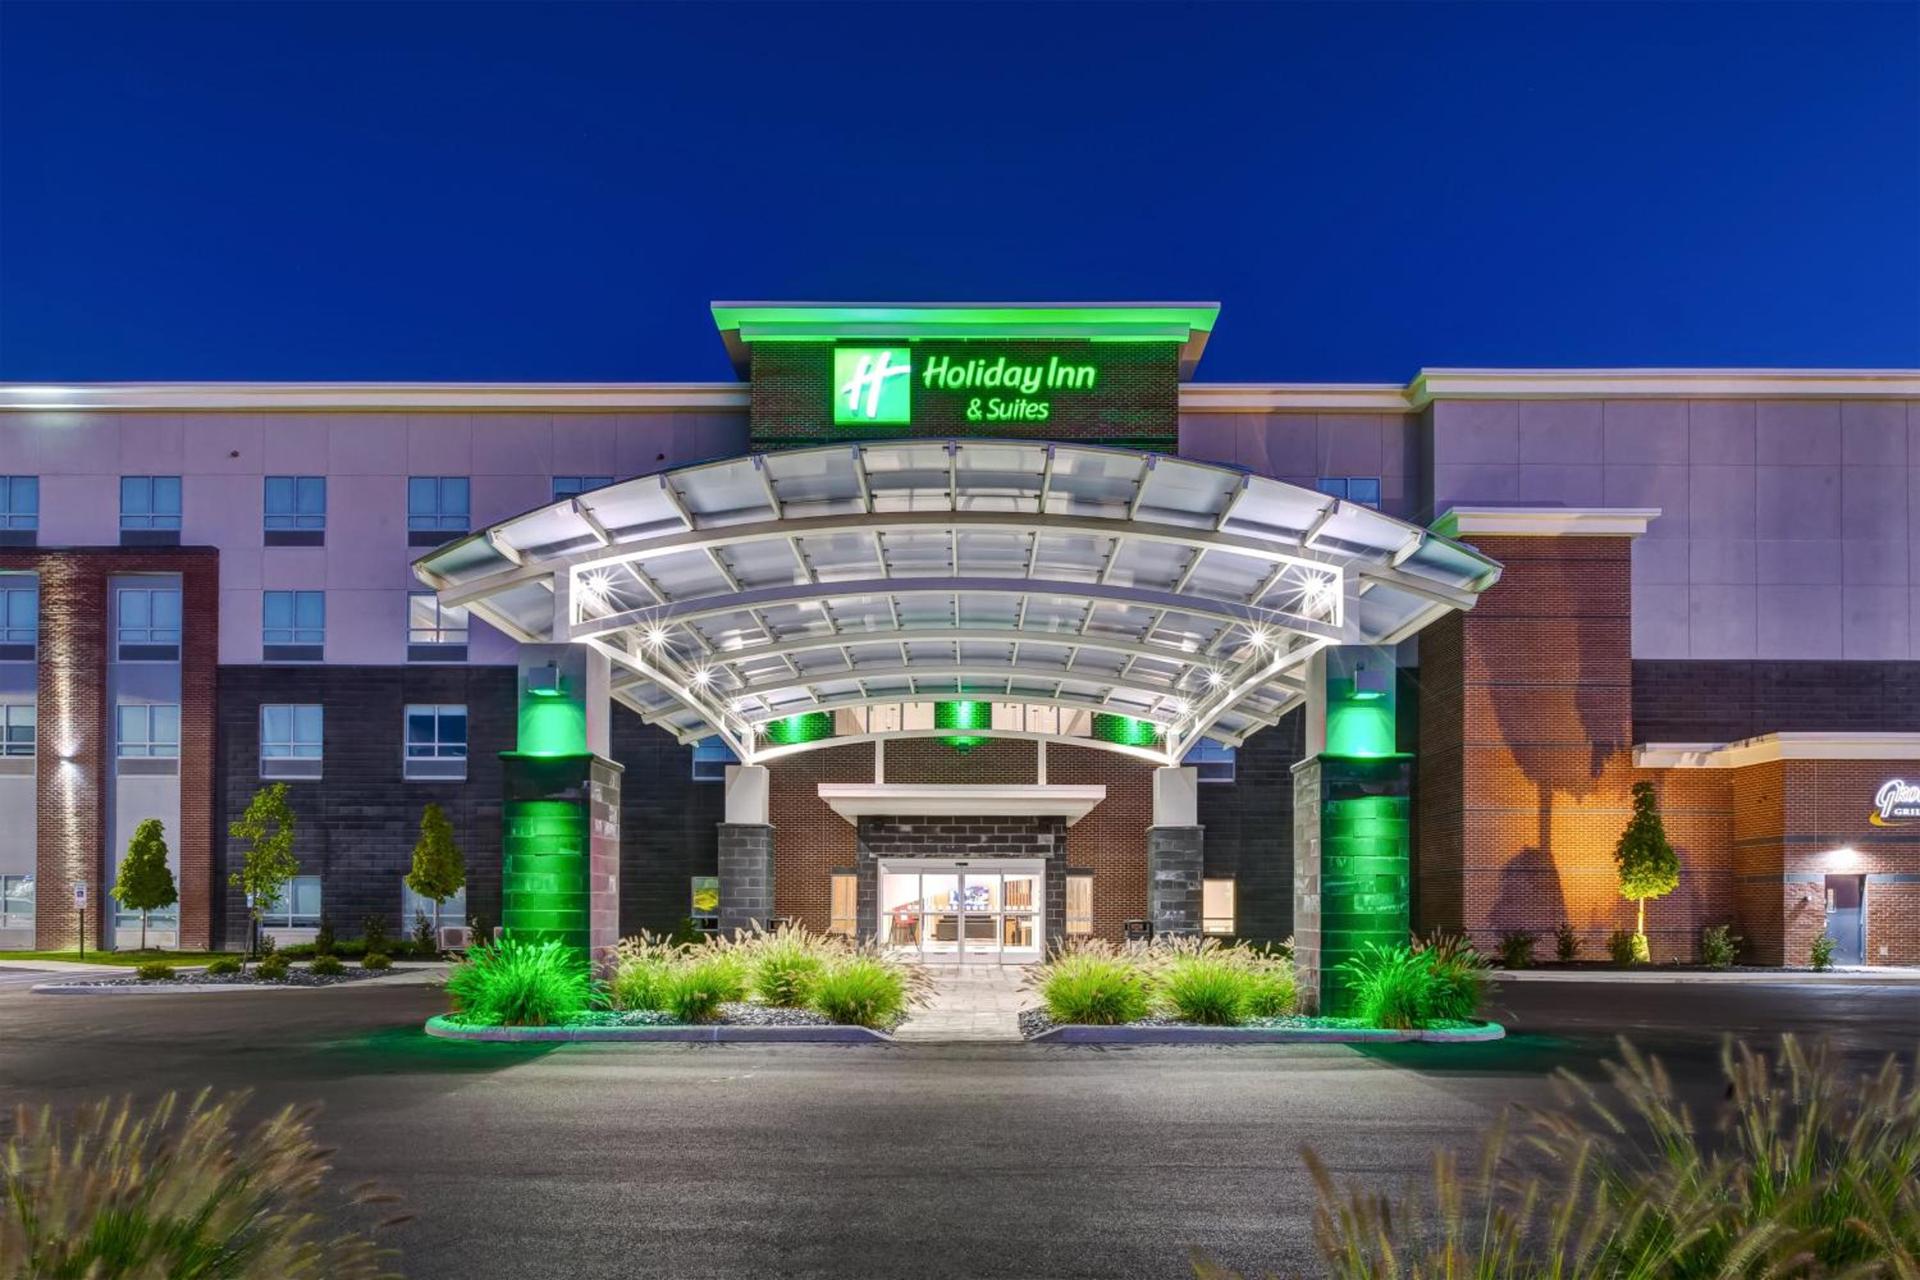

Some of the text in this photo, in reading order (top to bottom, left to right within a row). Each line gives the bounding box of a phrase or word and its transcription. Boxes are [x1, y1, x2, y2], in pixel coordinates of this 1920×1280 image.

[922, 356, 1096, 394] Holiday Inn
[966, 398, 1049, 421] & Suites
